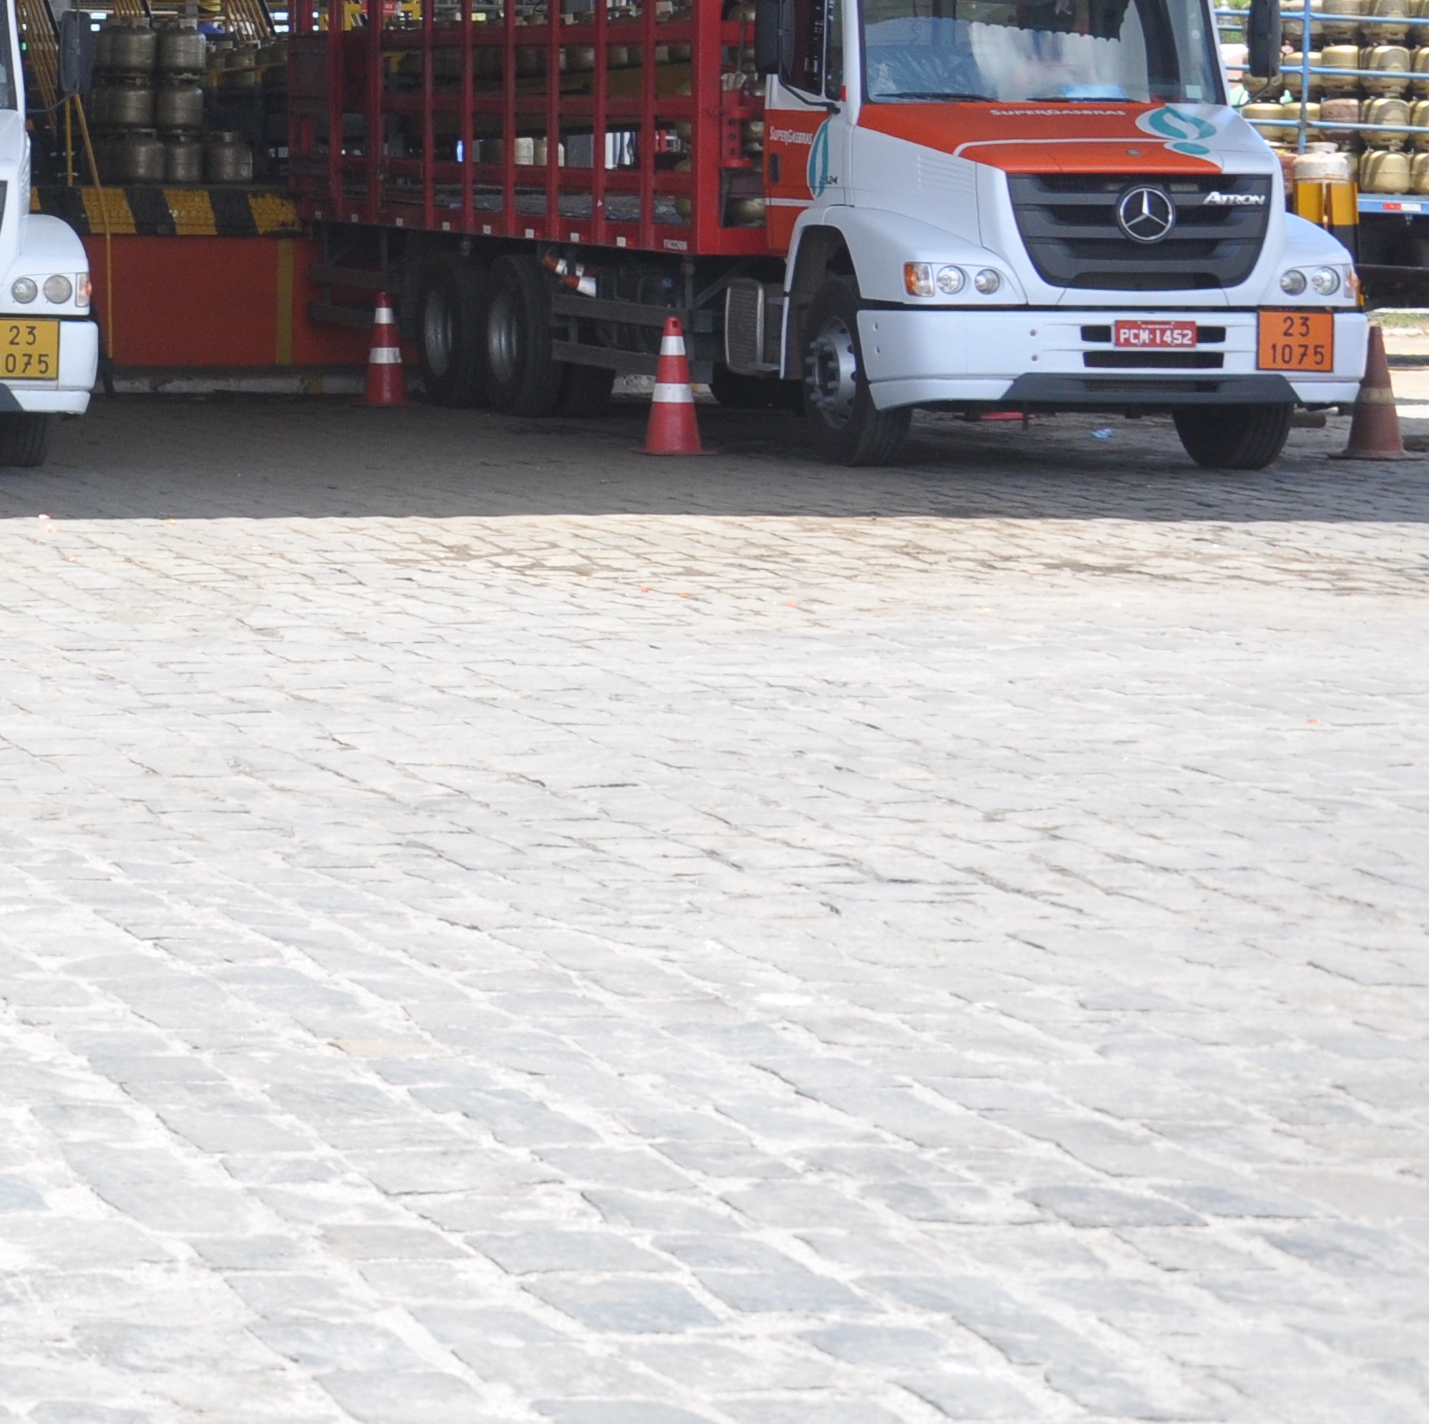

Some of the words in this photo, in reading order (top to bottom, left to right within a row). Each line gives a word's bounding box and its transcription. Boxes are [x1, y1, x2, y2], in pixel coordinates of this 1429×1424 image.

[1202, 191, 1266, 205] ATRON
[8, 325, 37, 346] 23
[1283, 316, 1311, 338] 23
[1270, 343, 1325, 366] 1075
